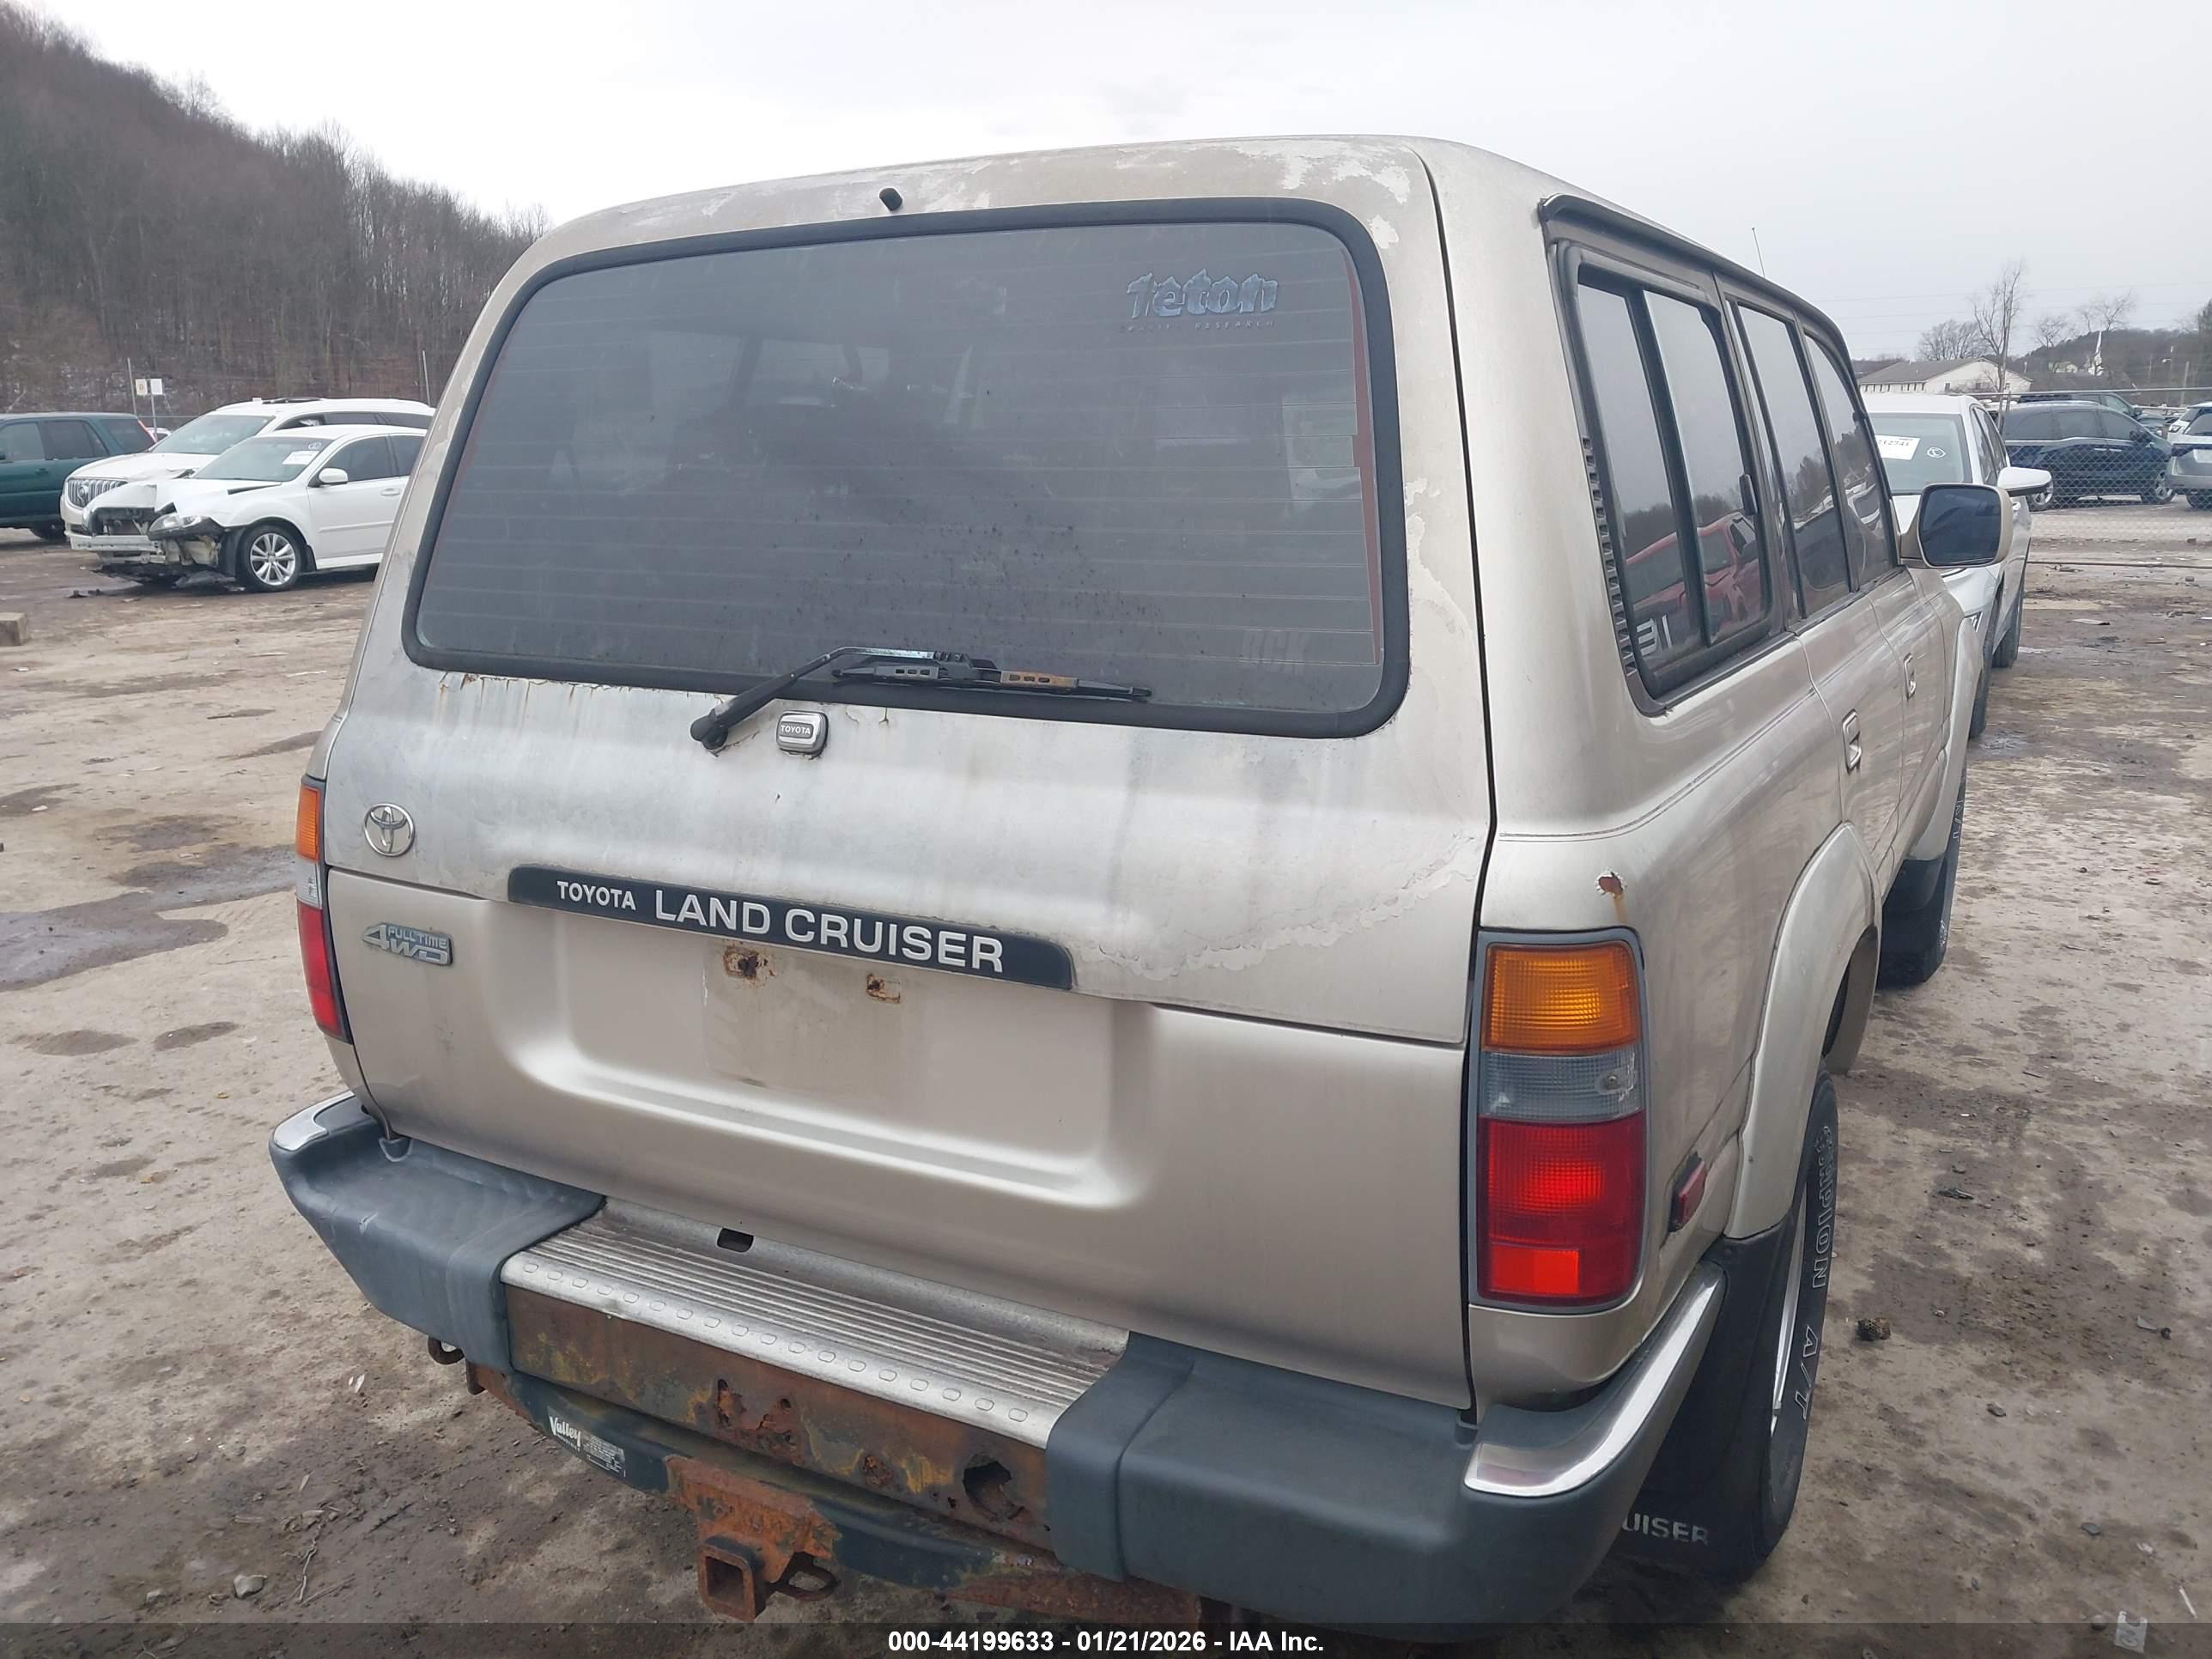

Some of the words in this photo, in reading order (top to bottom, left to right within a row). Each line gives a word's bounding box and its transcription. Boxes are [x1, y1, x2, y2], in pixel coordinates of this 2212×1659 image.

[781, 725, 811, 735] TOYOTA
[388, 927, 416, 942] FULL
[417, 933, 447, 949] TIME
[556, 880, 636, 910] TOYOTA
[653, 890, 770, 935] LAND
[784, 908, 1003, 973] CRUISER
[1795, 1325, 1818, 1420] A/T
[550, 1415, 581, 1448] Valley
